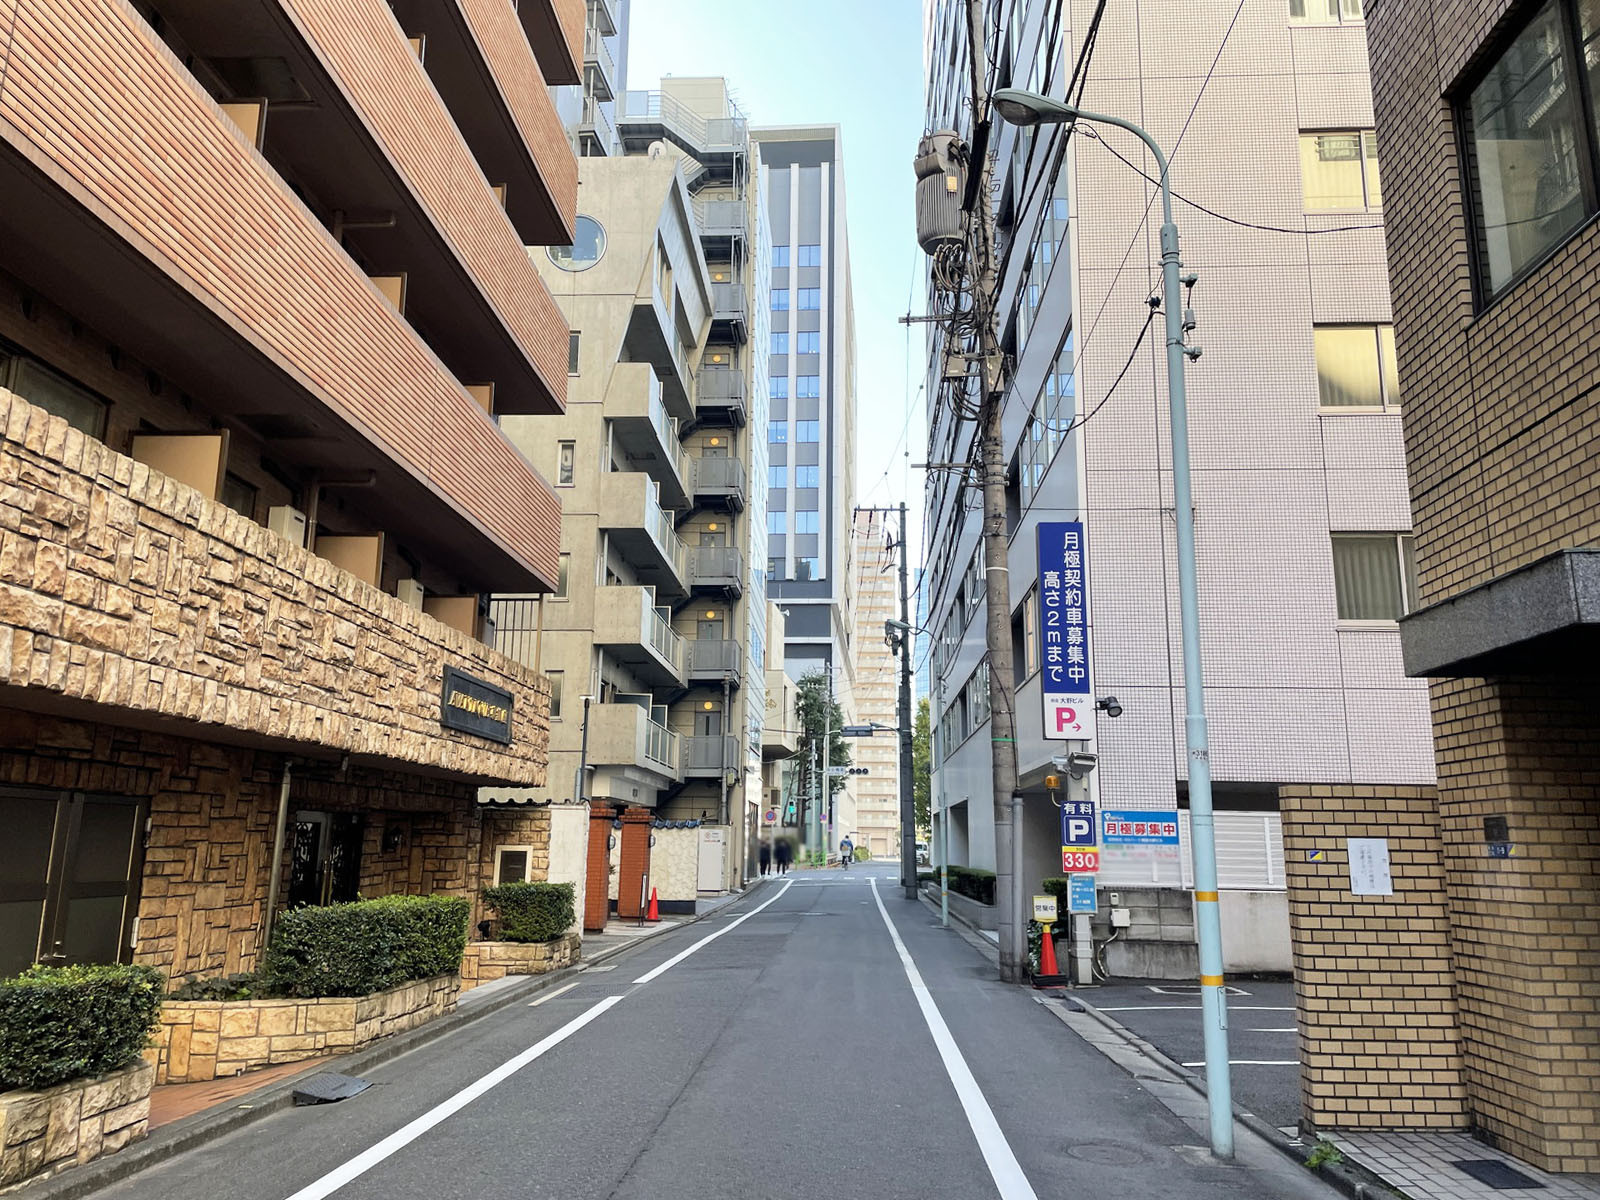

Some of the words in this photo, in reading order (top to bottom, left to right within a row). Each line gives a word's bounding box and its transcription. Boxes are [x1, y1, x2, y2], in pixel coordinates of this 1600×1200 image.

[1063, 531, 1085, 684] 月極契約車募集中
[1044, 570, 1062, 682] 高さ2mまで
[1056, 707, 1076, 732] P
[1063, 802, 1092, 815] 有料
[1069, 819, 1090, 842] P
[1106, 823, 1175, 835] 月極募集中
